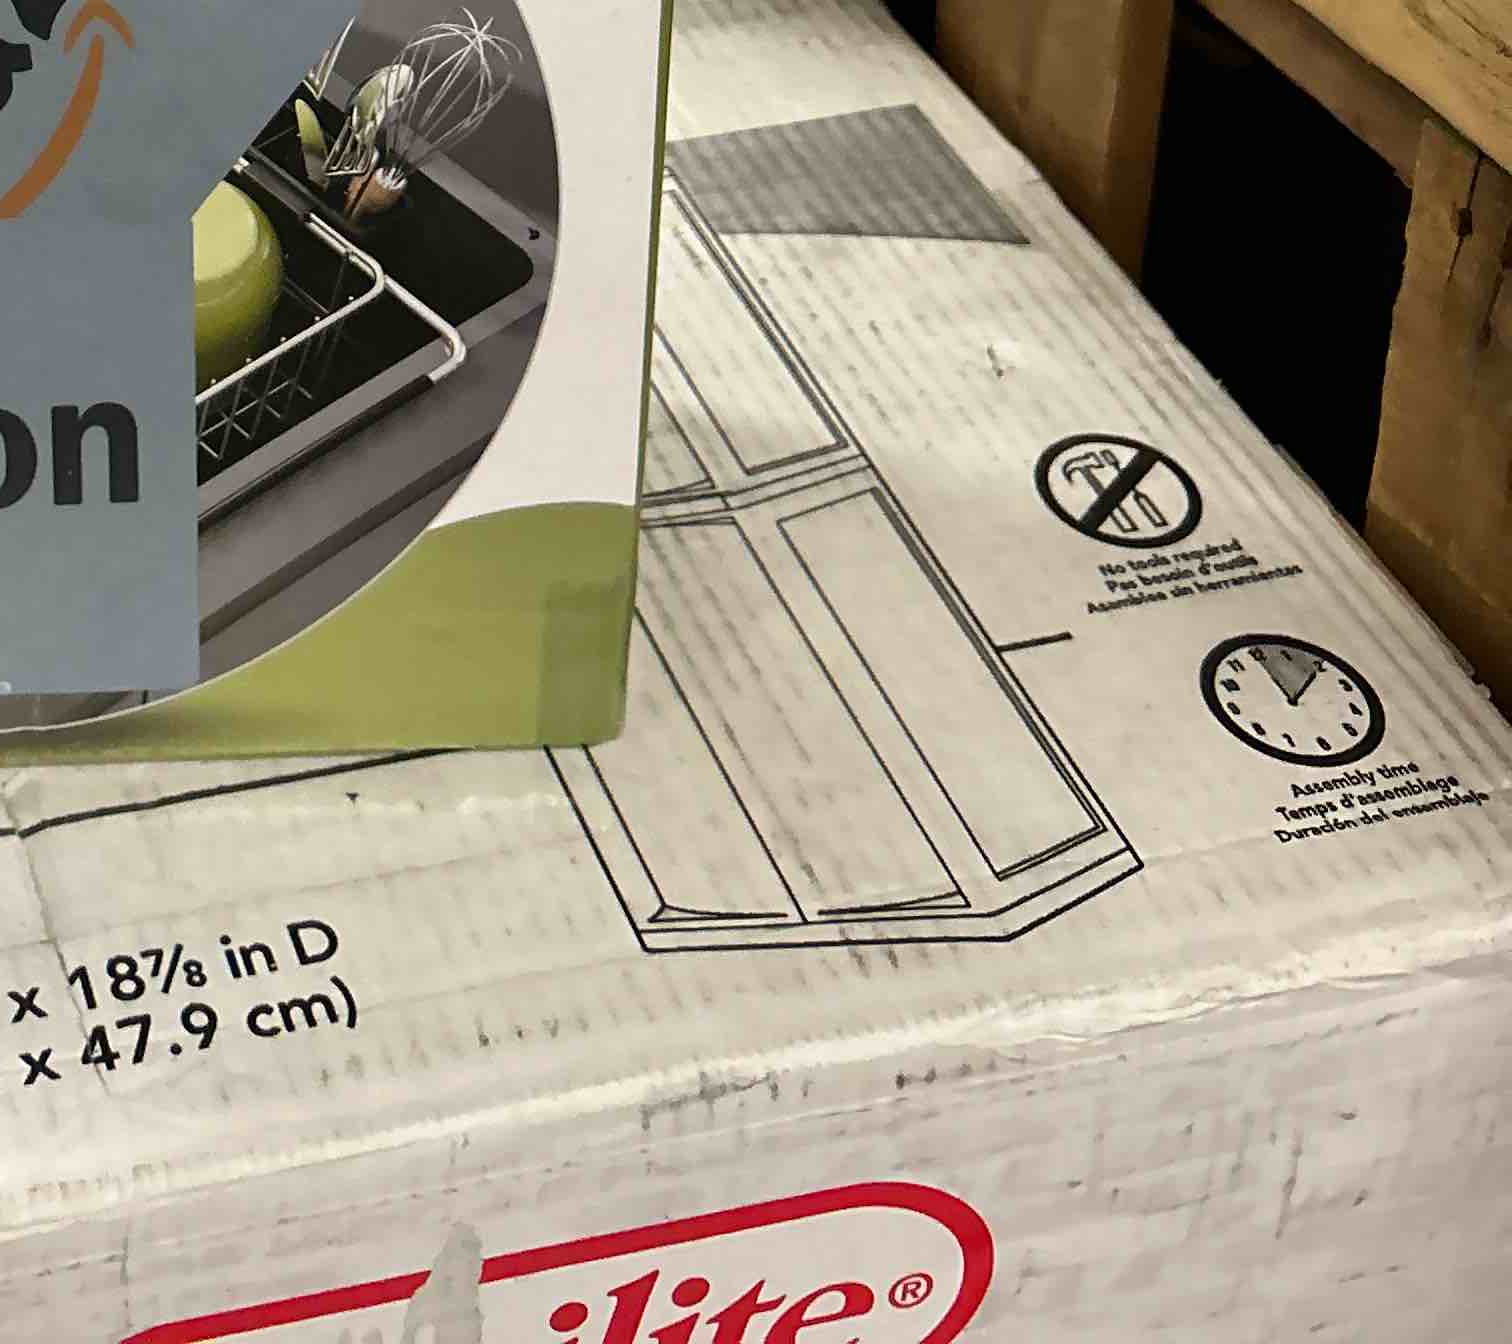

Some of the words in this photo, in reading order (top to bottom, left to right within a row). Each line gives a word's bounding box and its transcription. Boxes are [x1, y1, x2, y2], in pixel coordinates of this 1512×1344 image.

[1098, 563, 1127, 577] No
[1127, 553, 1171, 571] tools
[1172, 538, 1243, 563] required
[1290, 769, 1377, 800] Assembly
[1377, 761, 1420, 780] time
[1273, 819, 1359, 844] Duración
[1360, 808, 1391, 826] del
[1391, 789, 1490, 818] ensamblaje
[1275, 801, 1338, 823] Temps
[7, 987, 49, 1024] x
[219, 934, 279, 979] in
[286, 919, 339, 966] D
[18, 1047, 62, 1086] x
[80, 1002, 218, 1071] 47.9
[246, 975, 358, 1038] cm)
